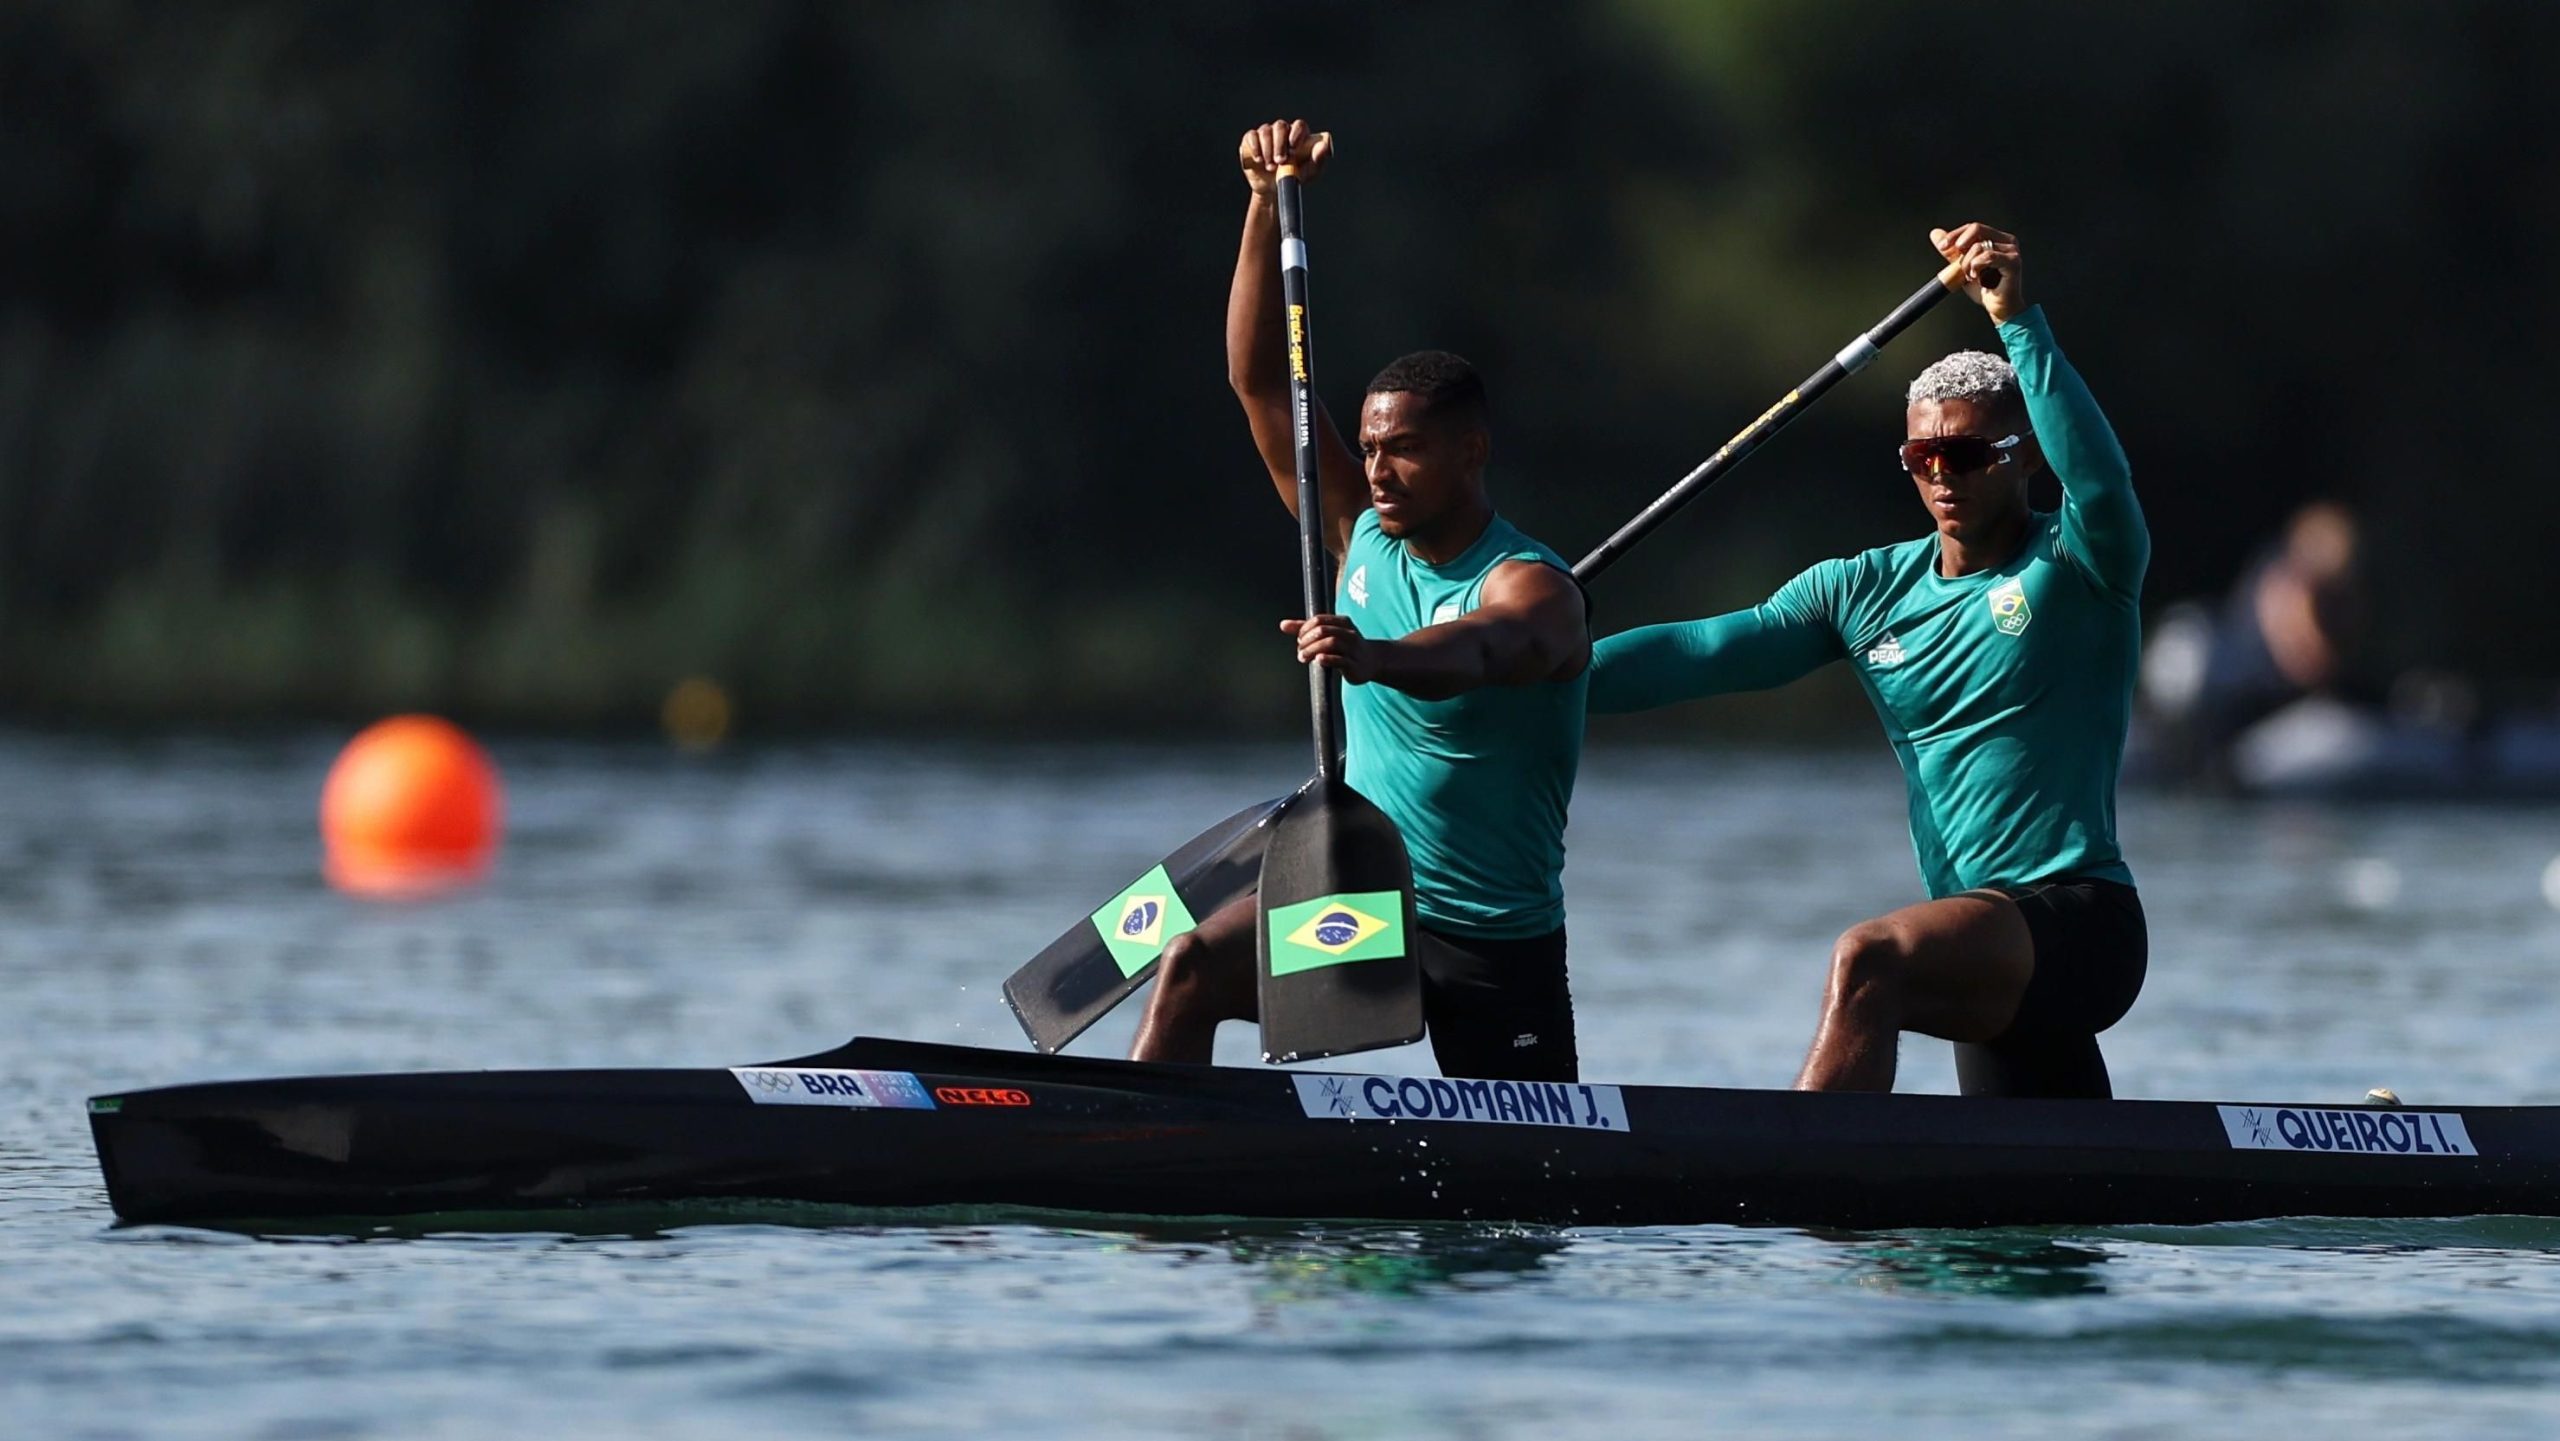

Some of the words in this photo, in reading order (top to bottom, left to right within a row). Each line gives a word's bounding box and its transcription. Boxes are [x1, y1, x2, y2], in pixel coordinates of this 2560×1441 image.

[1868, 649, 1907, 665] PEAK
[1513, 1035, 1538, 1048] PEAK
[797, 1073, 864, 1097] BRA
[879, 1086, 922, 1098] 2024
[942, 1088, 1028, 1105] NELO
[1363, 1076, 1575, 1125] GODMANN
[1578, 1085, 1610, 1128] J.
[2276, 1109, 2434, 1153] QUEIROZ
[2430, 1115, 2460, 1154] I.
